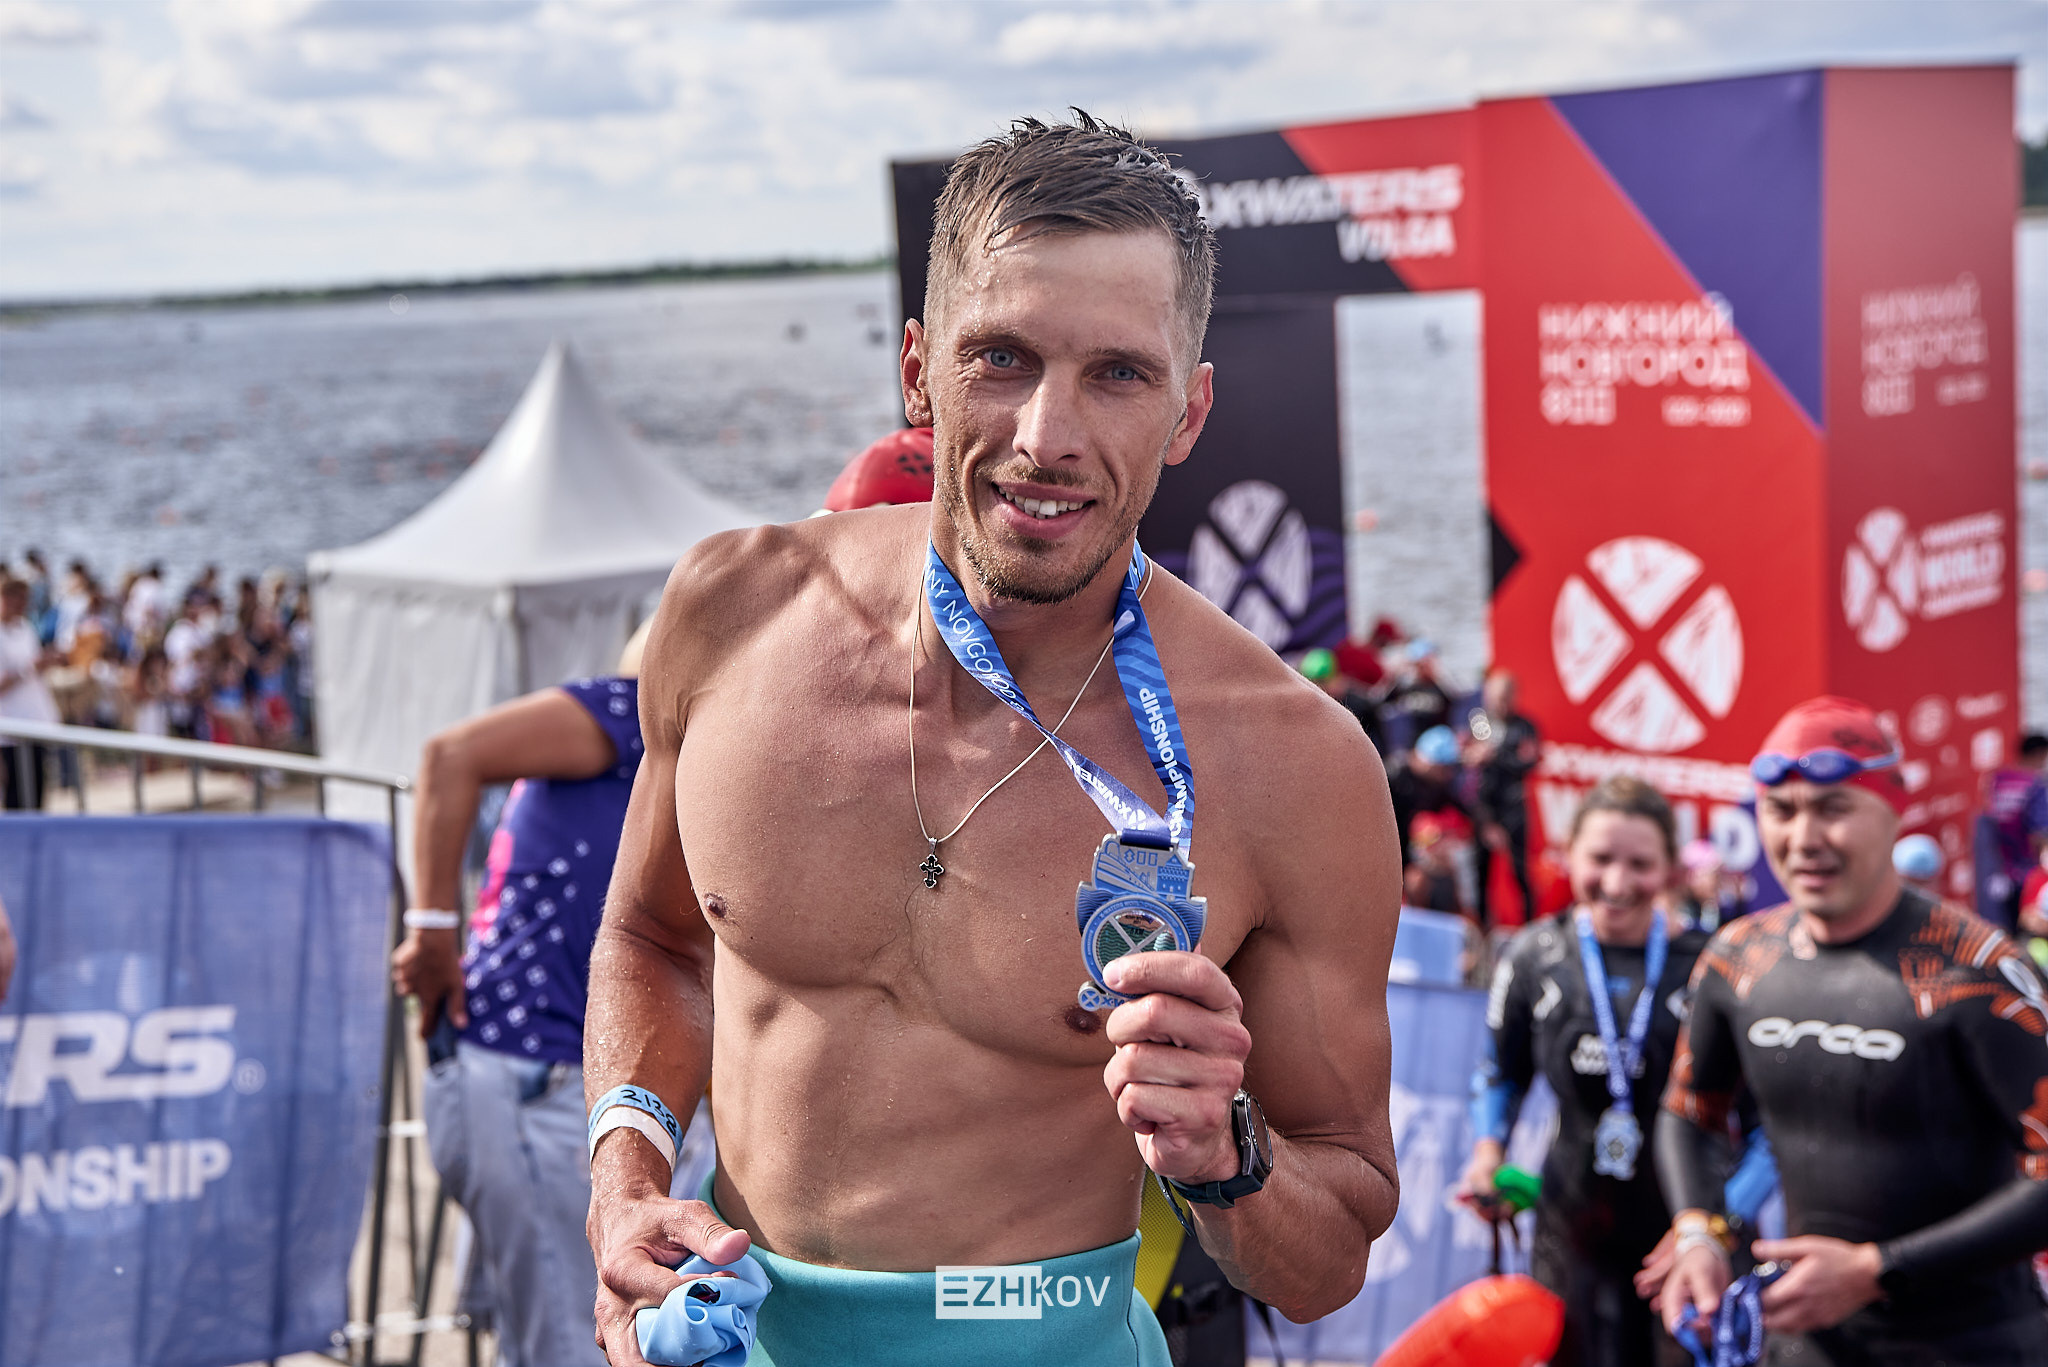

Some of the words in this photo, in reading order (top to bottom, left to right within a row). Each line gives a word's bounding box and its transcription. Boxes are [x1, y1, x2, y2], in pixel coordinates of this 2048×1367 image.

[1541, 293, 1732, 342] НИЖНИЙ
[1541, 343, 1749, 389] НОВГОРОД
[1863, 322, 1987, 373] НОВГОРОД
[1542, 383, 1615, 424] 800
[926, 562, 949, 599] NY
[1139, 687, 1188, 837] CHAMPIONSHIP
[1748, 1017, 1906, 1062] orca
